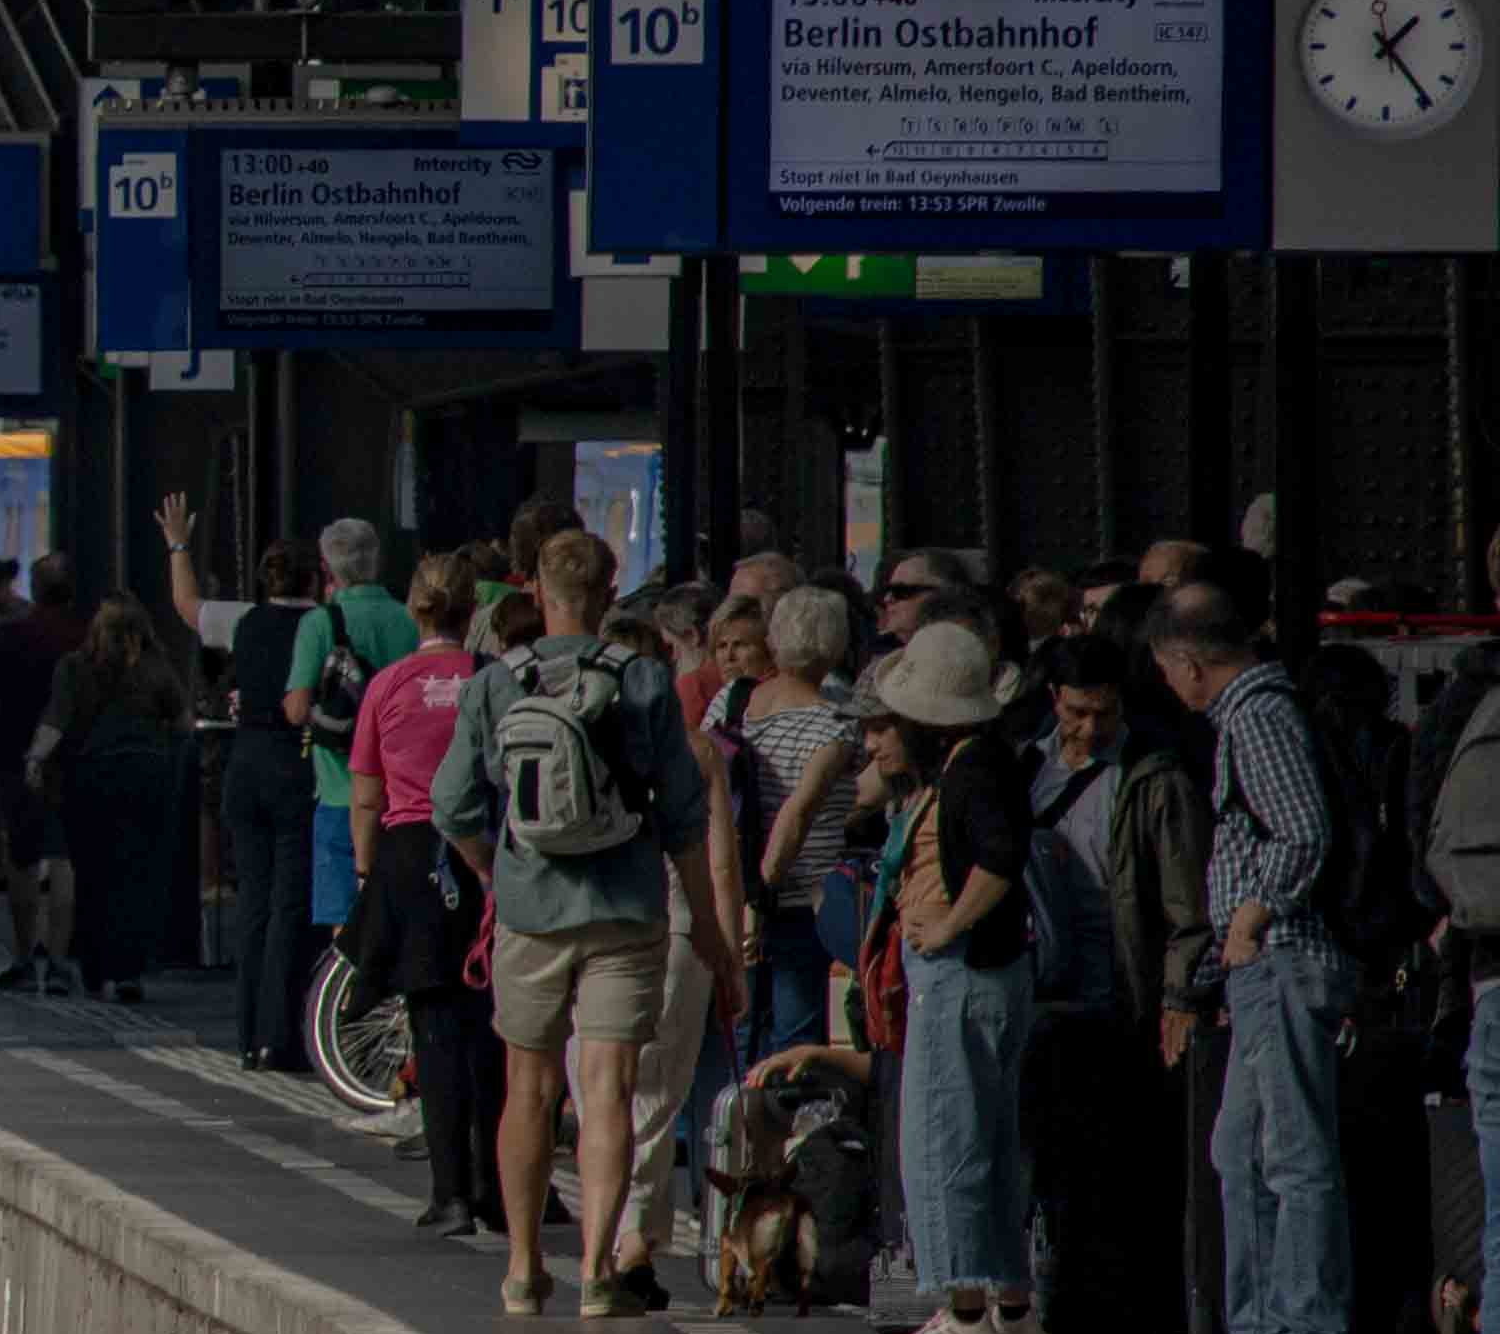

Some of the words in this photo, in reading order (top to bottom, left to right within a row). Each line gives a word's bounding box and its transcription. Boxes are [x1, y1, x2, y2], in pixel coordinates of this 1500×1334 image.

[619, 0, 699, 56] 10b
[784, 17, 882, 48] Berlin
[895, 15, 1099, 48] Ostbahnhof
[782, 59, 811, 76] via
[817, 58, 917, 79] Hilversum,
[923, 58, 1035, 76] Amersfoort
[1071, 58, 1180, 80] Apeldoorn,
[781, 85, 875, 106] Deventer,
[879, 84, 952, 106] Almelo,
[960, 84, 1045, 107] Hengelo,
[1052, 85, 1088, 103] Bad
[1094, 85, 1192, 107] Bentheim,
[229, 154, 292, 173] 13:00
[413, 156, 492, 176] Intercity
[779, 169, 823, 188] Stopt
[829, 169, 860, 185] niet
[865, 169, 880, 185] in
[885, 169, 915, 185] Bad
[920, 169, 1019, 188] Oeynhausen
[229, 181, 302, 205] Berlin
[311, 180, 461, 205] Ostbahnhof
[779, 196, 855, 216] Volgende
[859, 196, 903, 212] trein:
[956, 197, 989, 213] SPR
[993, 196, 1049, 213] Zwolle
